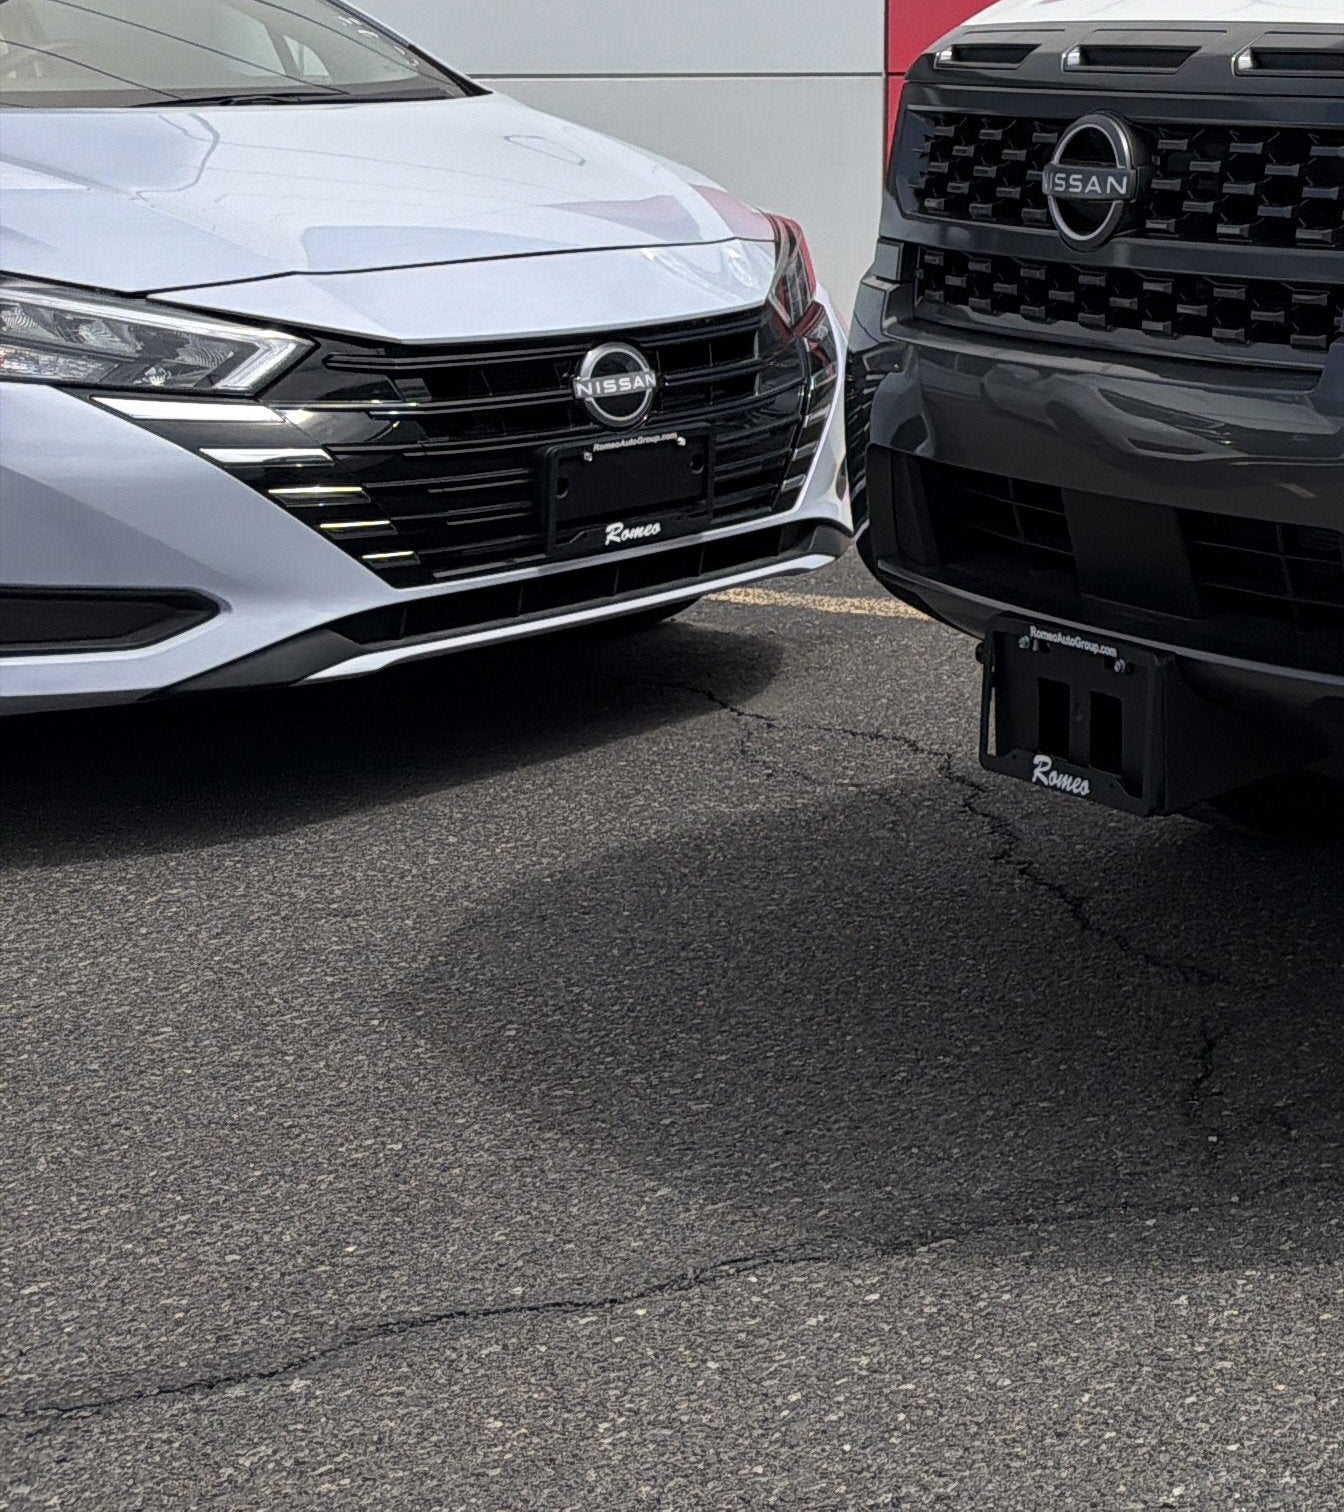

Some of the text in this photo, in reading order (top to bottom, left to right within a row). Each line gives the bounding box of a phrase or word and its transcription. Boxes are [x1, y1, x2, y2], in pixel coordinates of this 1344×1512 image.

[576, 372, 657, 397] NISSAN
[592, 431, 678, 452] RomeoAutoGroup.com
[604, 521, 662, 546] Romeo
[1030, 625, 1118, 658] RomeoAutoGroup.com
[1032, 754, 1090, 796] Romeo
